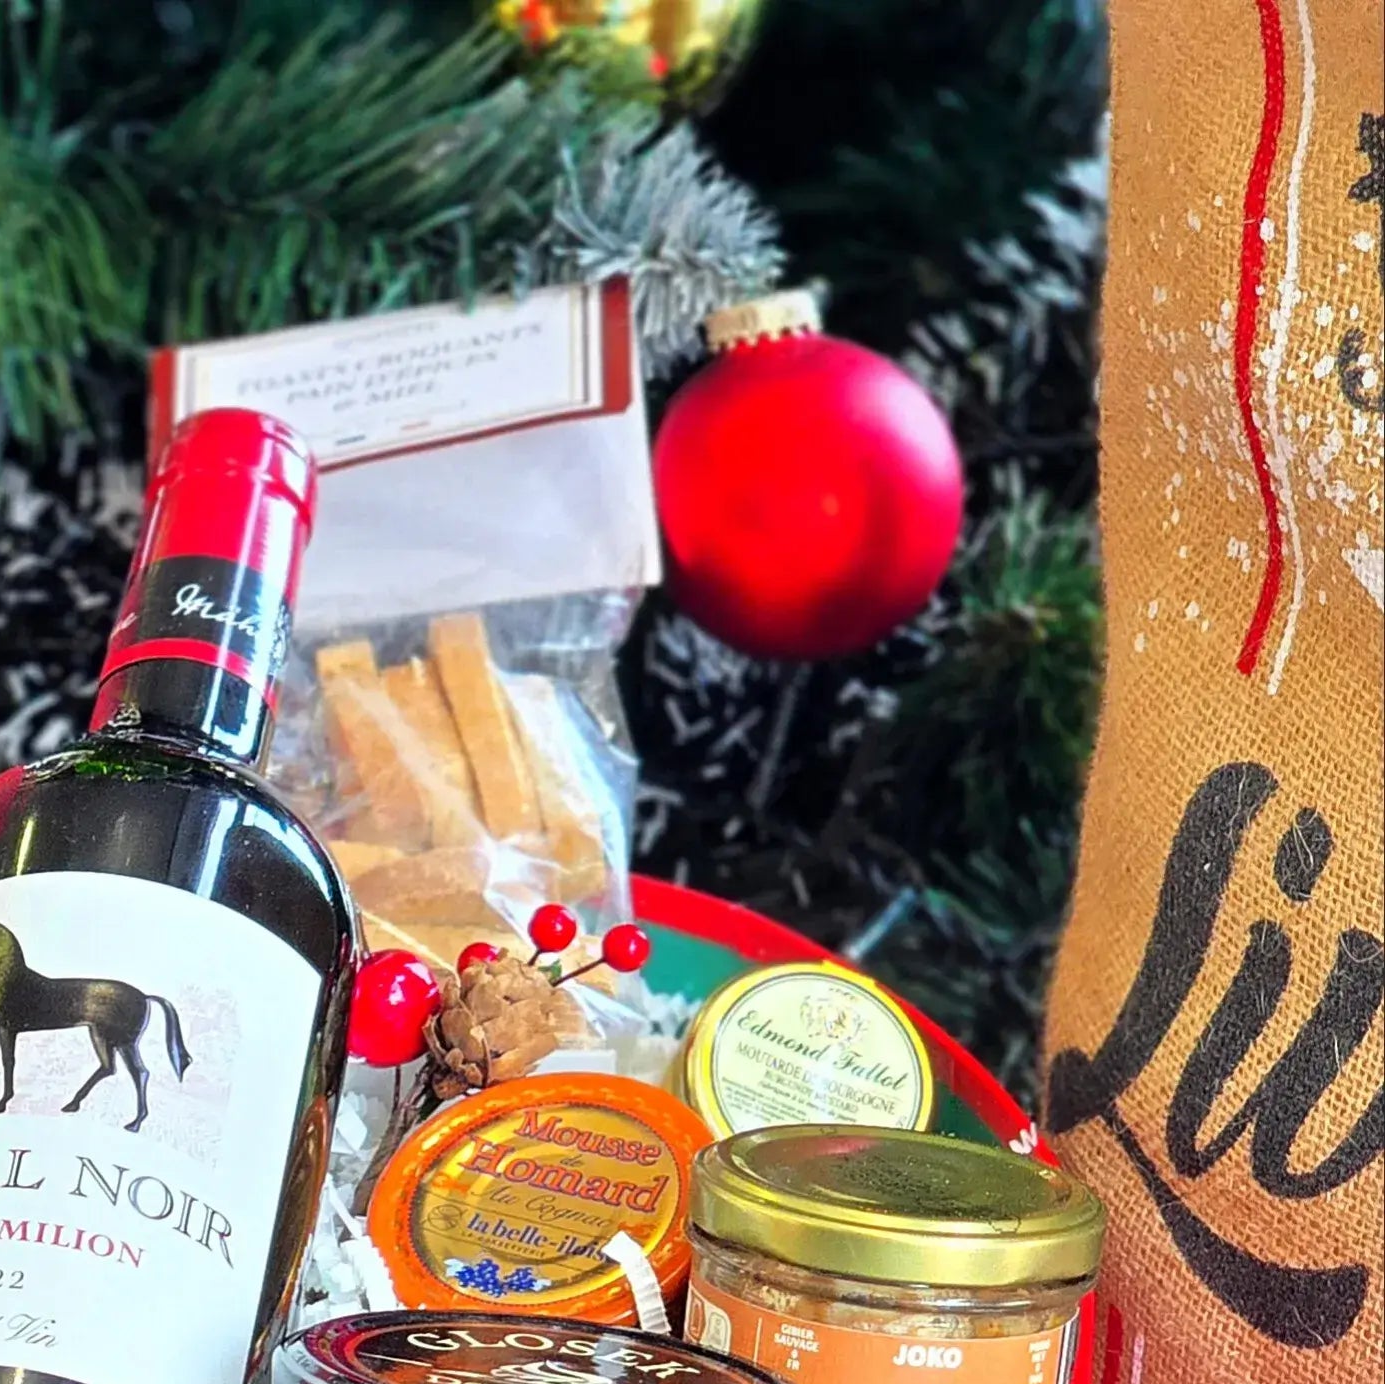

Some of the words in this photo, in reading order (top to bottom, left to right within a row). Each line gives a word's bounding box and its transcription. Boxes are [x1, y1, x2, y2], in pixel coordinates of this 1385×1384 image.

[736, 1041, 803, 1078] MOUTARDE
[737, 1010, 831, 1062] Edmond
[833, 1050, 908, 1091] Fallot
[515, 1111, 662, 1166] Mousse
[459, 1135, 670, 1214] Homard
[68, 1154, 236, 1270] NOIR
[525, 1194, 613, 1228] Cognac
[492, 1218, 618, 1264] belle-ilois
[7, 1313, 60, 1348] Vin
[407, 1329, 701, 1380] GLOSEK
[893, 1344, 965, 1369] JOKO
